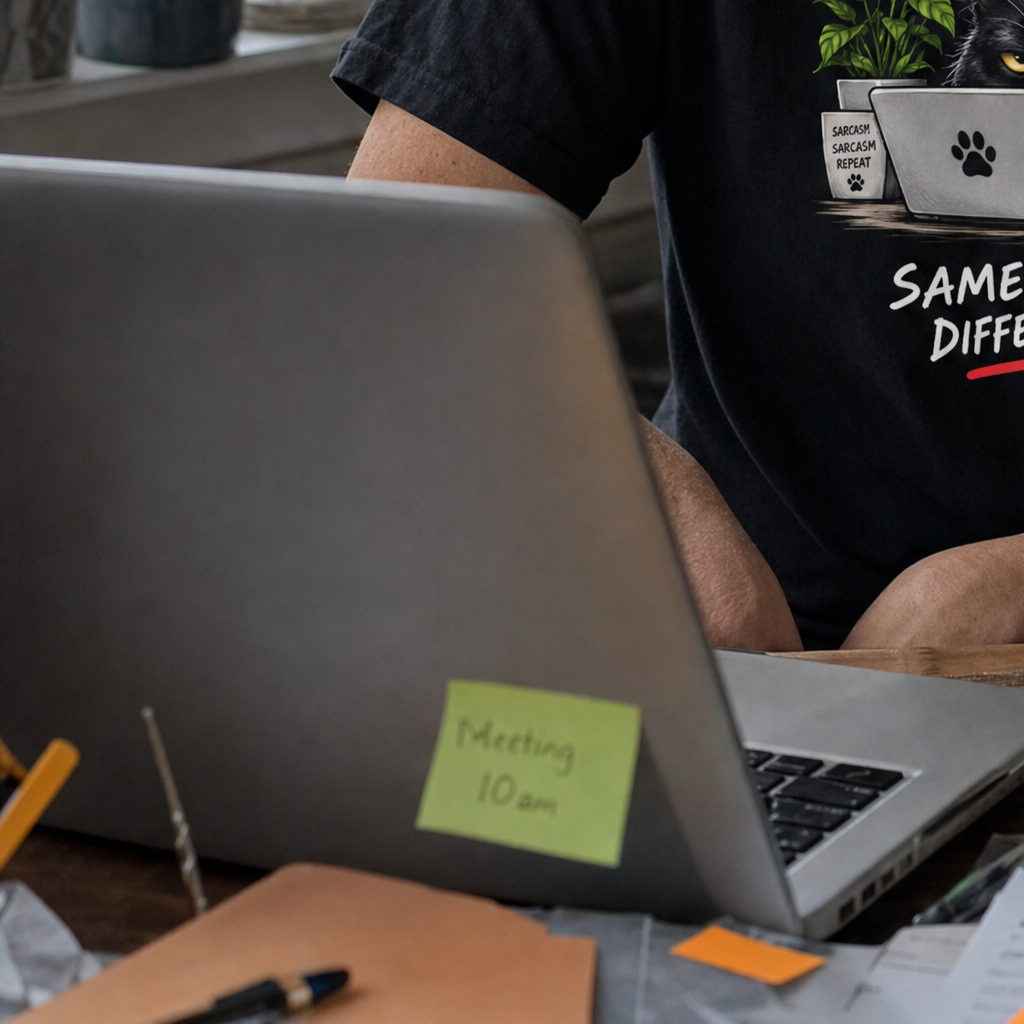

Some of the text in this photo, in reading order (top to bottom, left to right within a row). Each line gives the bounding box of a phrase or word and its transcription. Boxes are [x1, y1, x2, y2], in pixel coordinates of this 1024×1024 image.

[831, 123, 871, 138] SARCASM
[831, 139, 877, 155] SARCASM
[836, 156, 872, 170] REPEAT
[889, 261, 1024, 311] SAME
[455, 715, 576, 778] Meeting
